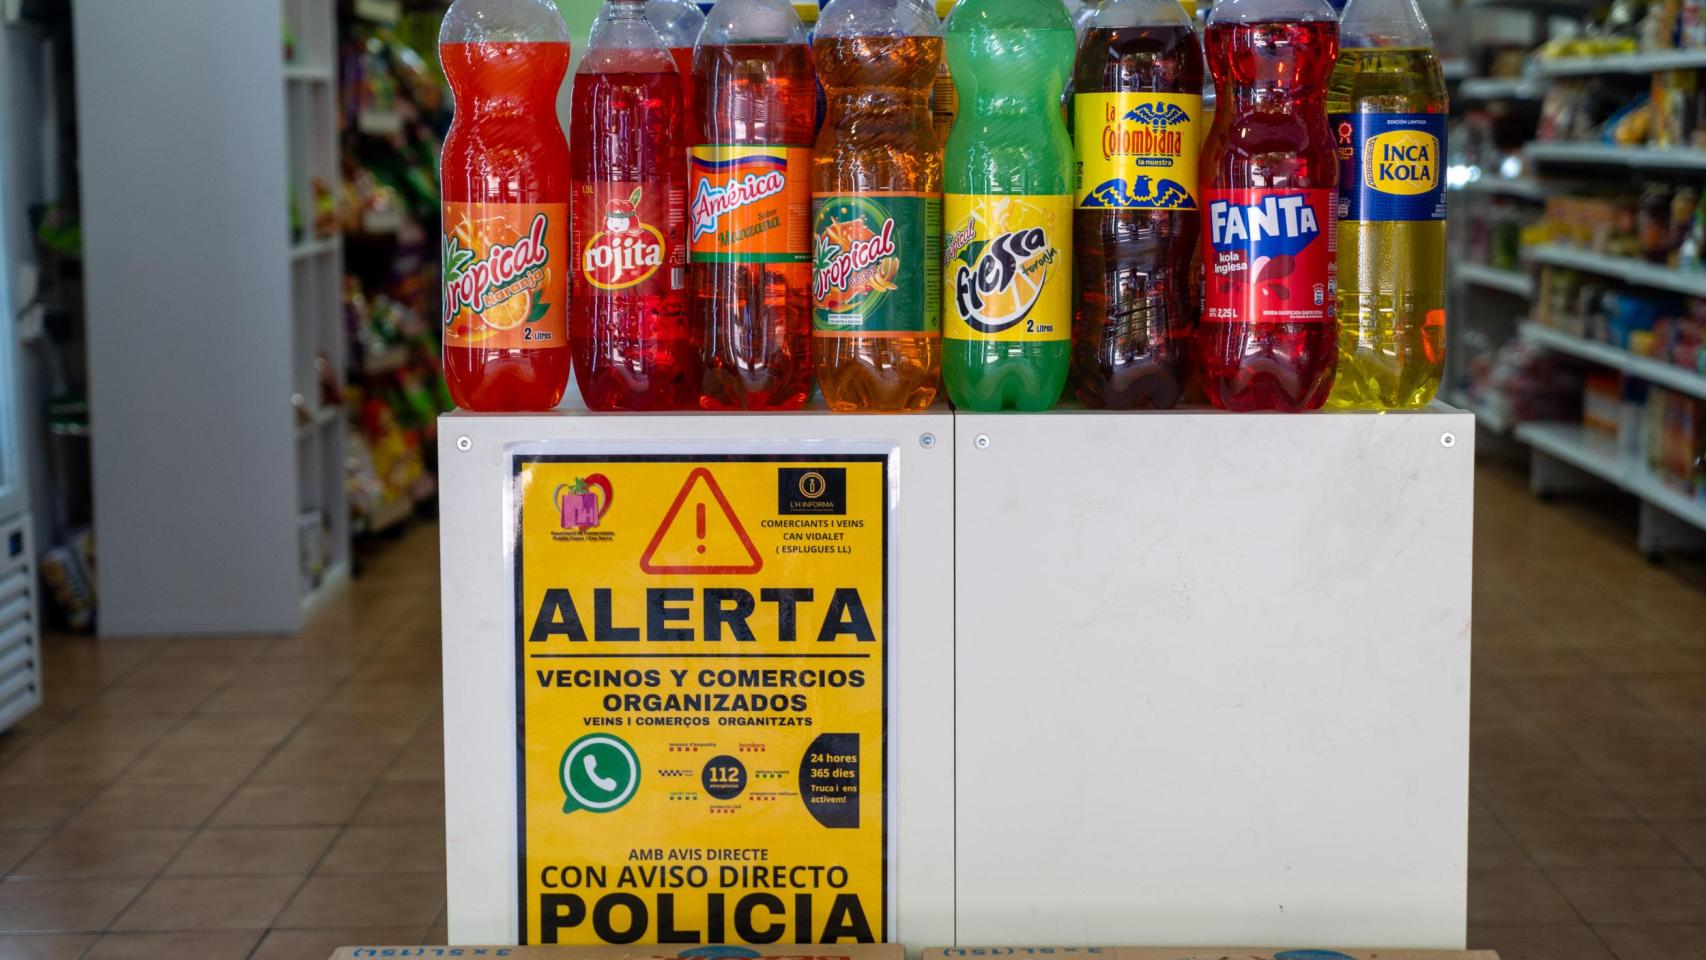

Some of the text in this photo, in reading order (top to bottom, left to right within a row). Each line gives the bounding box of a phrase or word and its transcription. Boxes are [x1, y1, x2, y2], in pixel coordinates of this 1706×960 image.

[1106, 102, 1116, 122] La
[1102, 124, 1182, 160] Colombiana
[1384, 144, 1429, 161] INCA
[1379, 163, 1431, 181] KOLA
[695, 172, 786, 225] América
[1211, 196, 1318, 244] FANTA
[585, 236, 663, 283] rojita
[1219, 253, 1239, 263] kola
[1214, 262, 1248, 275] inglesa
[482, 268, 544, 307] Naranja
[524, 327, 532, 340] 2
[1027, 319, 1034, 333] 2
[761, 520, 829, 528] COMERCIANTS
[836, 520, 864, 528] VEINS
[783, 533, 844, 541] CAN VIDALET
[837, 546, 852, 555] LL)
[528, 588, 877, 642] ALERTA
[537, 669, 865, 688] VECINOS Y COMERCIOS
[603, 693, 807, 712] ORGANIZADOS
[584, 717, 813, 728] VEINS I COMERÇOS ORGANITZATS
[811, 753, 857, 763] 24 hores
[710, 767, 739, 782] 112
[811, 768, 855, 778] 365 dies
[811, 784, 834, 792] Truca
[629, 849, 768, 860] AMB AVIS DIRECTE
[541, 866, 848, 888] CON AVISO DIRECTO
[540, 892, 875, 944] POLICIA
